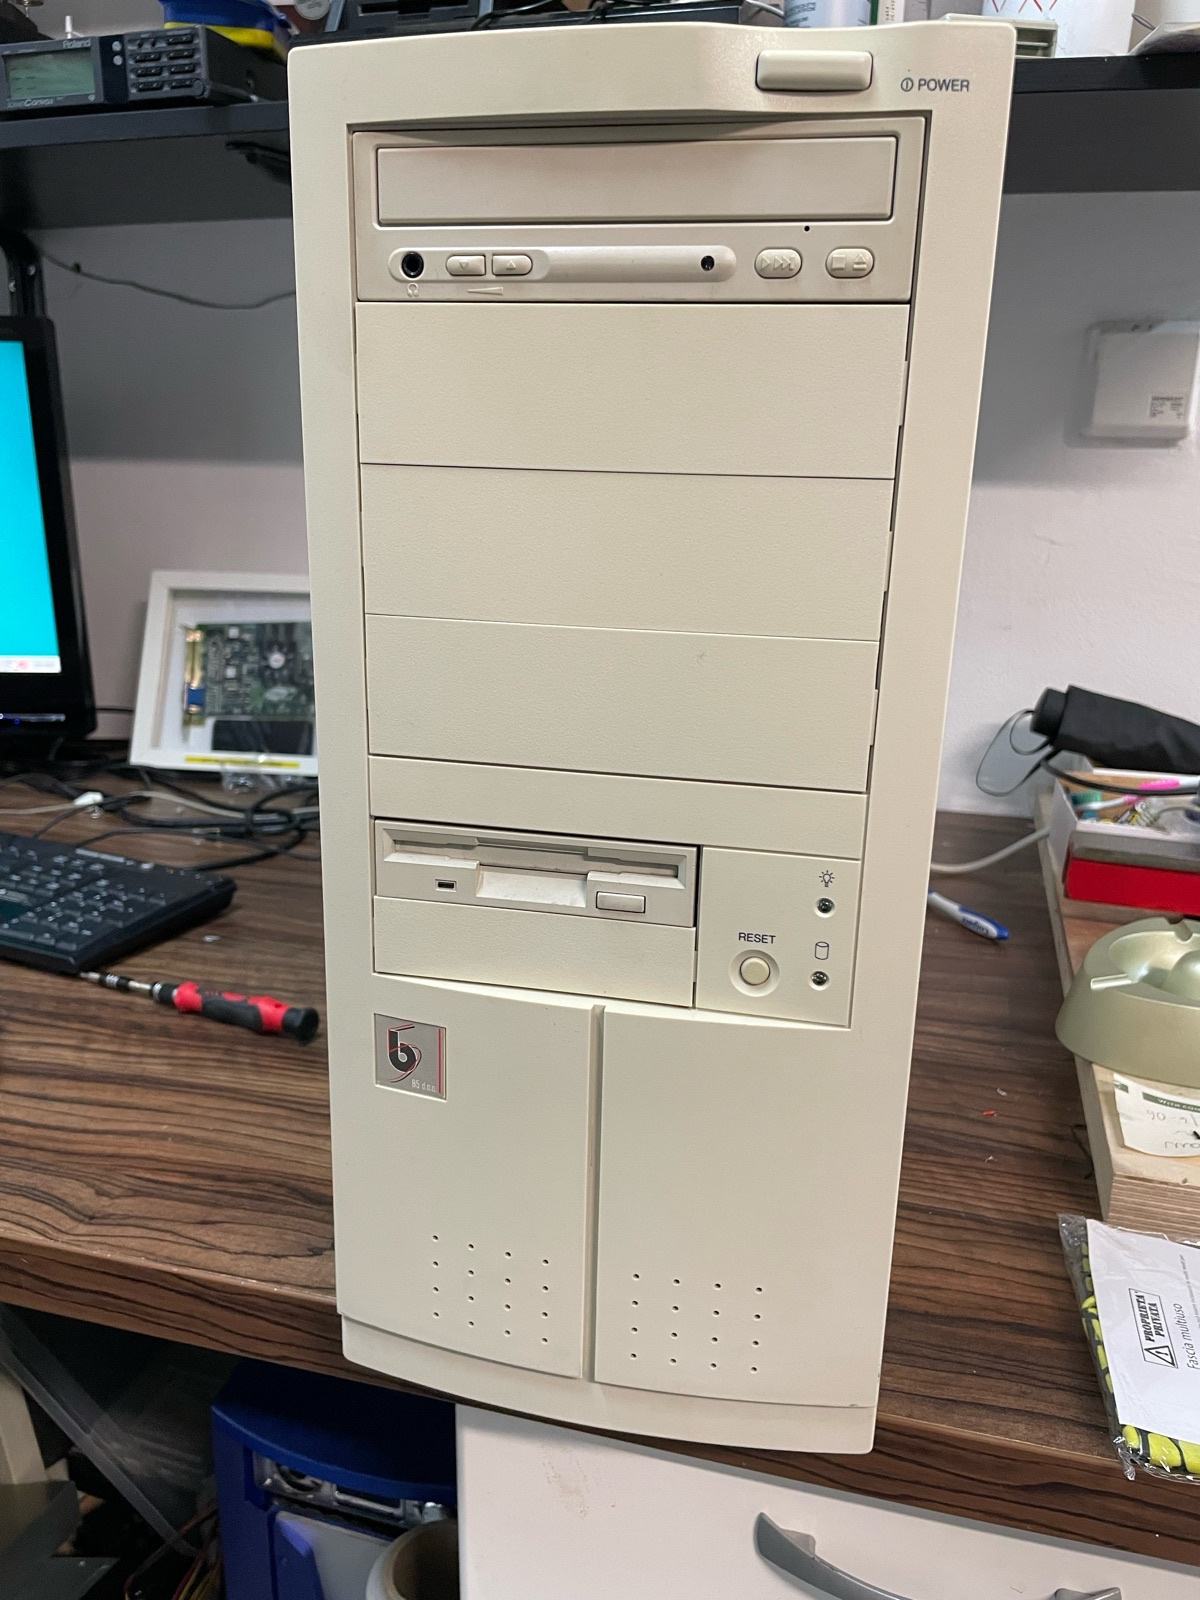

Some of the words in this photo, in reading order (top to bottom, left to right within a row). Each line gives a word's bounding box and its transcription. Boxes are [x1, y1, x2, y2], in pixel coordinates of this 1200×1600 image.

[918, 78, 970, 93] POWER
[738, 931, 777, 945] RESET
[1147, 1302, 1166, 1338] PRIVATA
[1172, 1303, 1193, 1341] multiuso
[1183, 1342, 1200, 1370] Fascia
